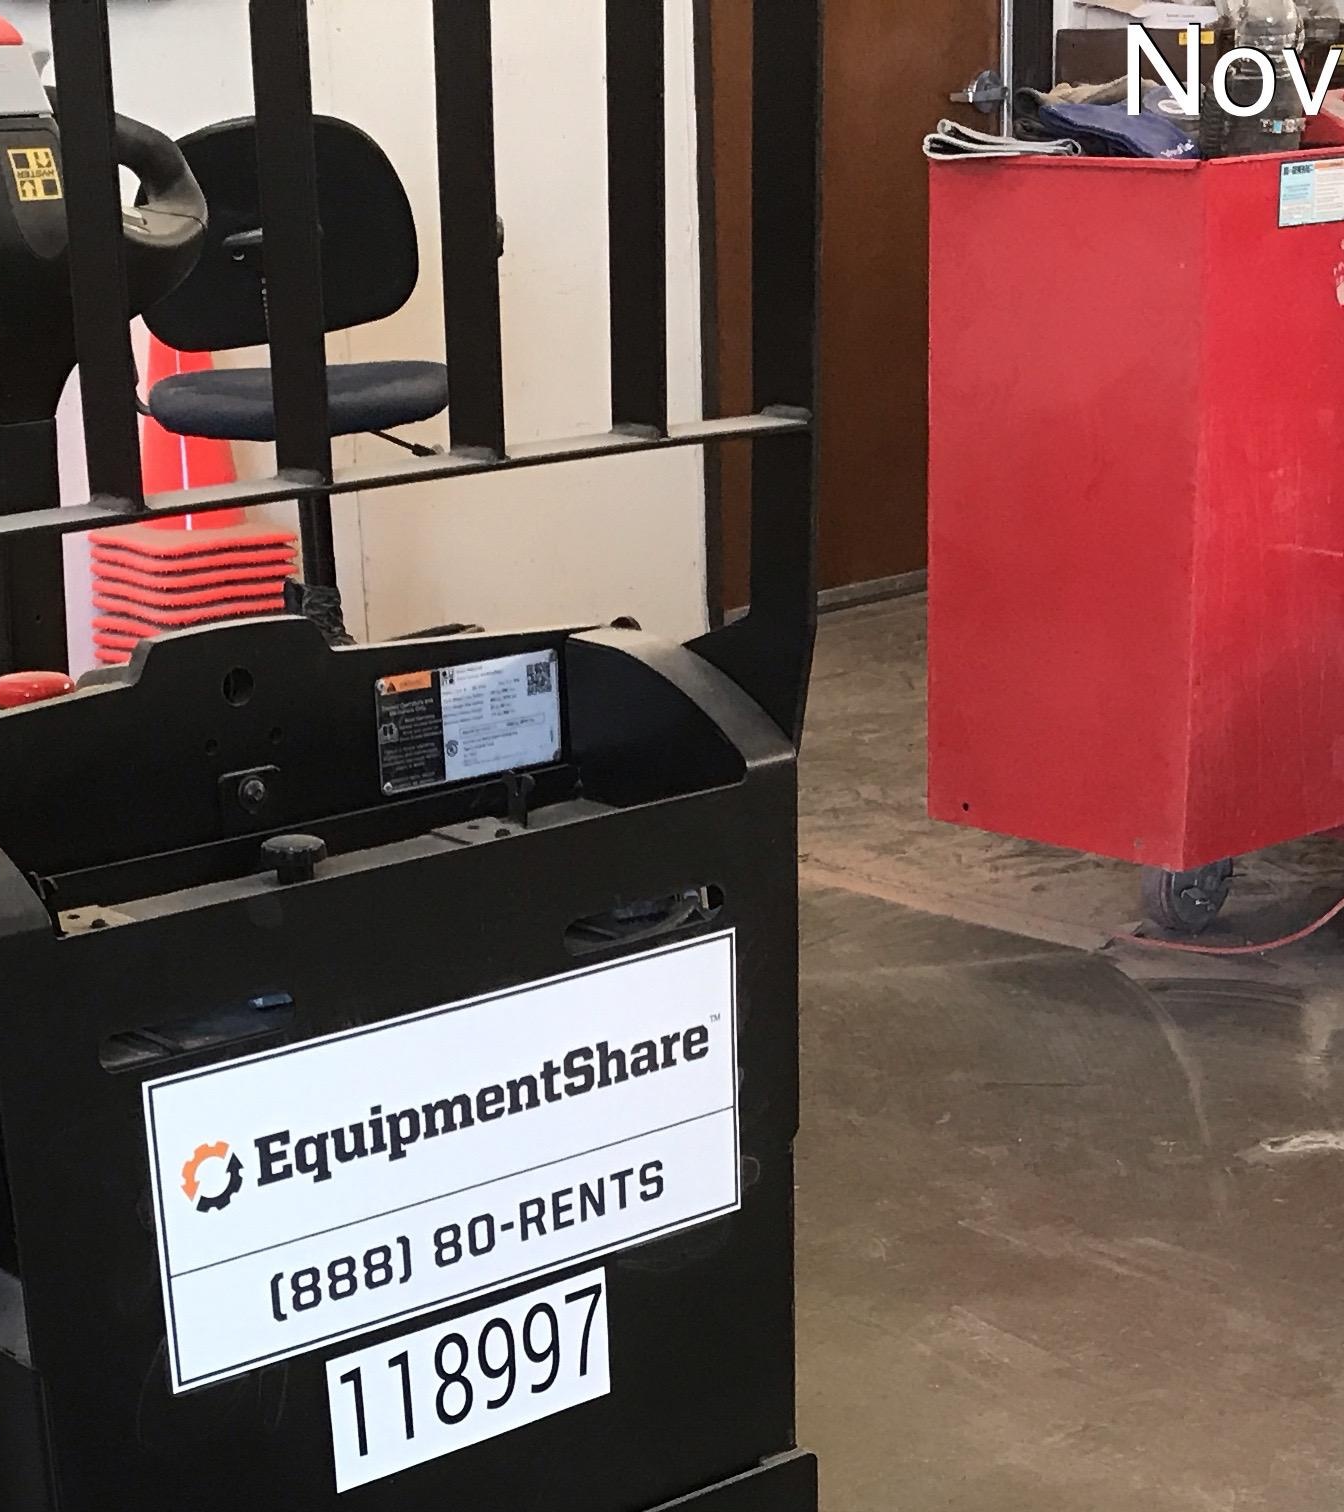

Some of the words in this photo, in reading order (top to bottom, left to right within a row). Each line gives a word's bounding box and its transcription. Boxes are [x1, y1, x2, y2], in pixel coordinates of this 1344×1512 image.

[253, 1021, 710, 1187] EquipmentShare
[270, 1236, 412, 1321] (888)
[433, 1160, 665, 1268] 80-RENTS
[338, 1283, 604, 1457] 118997
